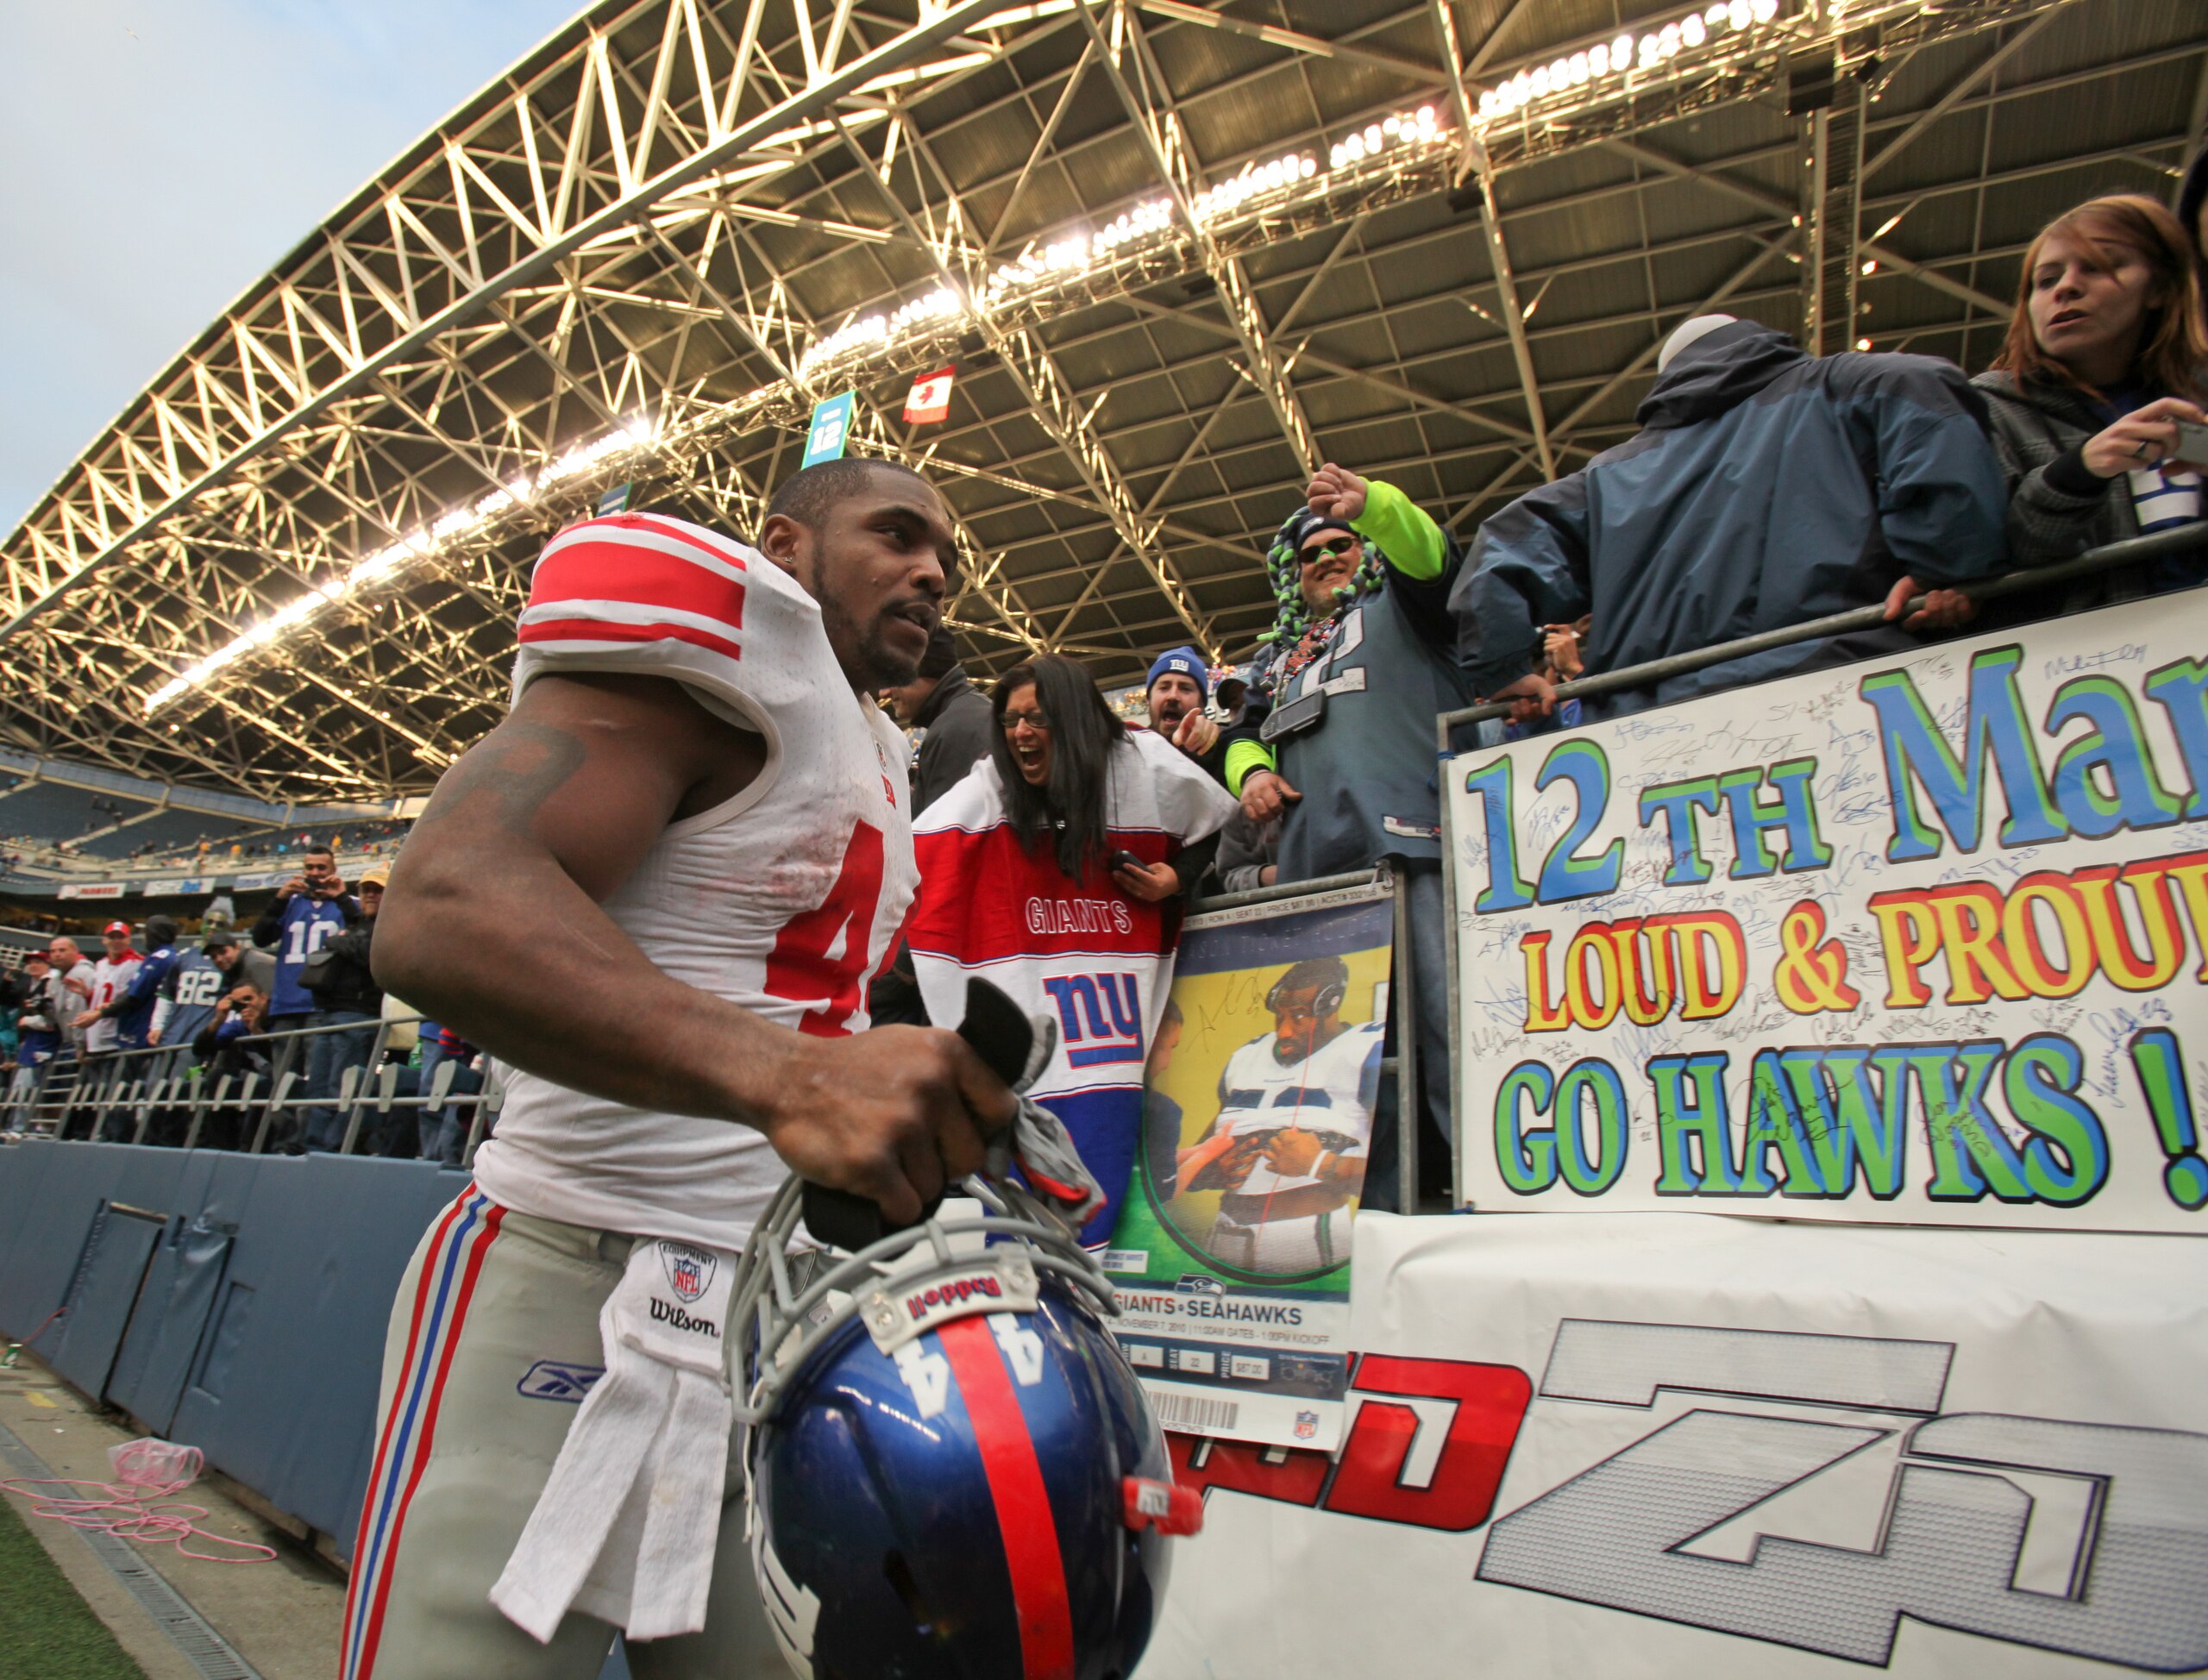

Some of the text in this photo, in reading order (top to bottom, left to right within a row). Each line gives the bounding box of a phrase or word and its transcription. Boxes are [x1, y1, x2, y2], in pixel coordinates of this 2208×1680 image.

[810, 420, 843, 455] 12
[1025, 896, 1132, 934] GIANTS
[1266, 902, 1289, 913] PRICE
[285, 920, 340, 964] 10
[1520, 909, 1748, 1032] LOUD
[1773, 899, 1860, 1016] &
[1867, 851, 2208, 1010] PROU
[176, 970, 223, 1006] 82
[1494, 1057, 1629, 1197] GO
[662, 1244, 714, 1266] EQUIPMENT
[674, 1270, 699, 1294] NFL
[906, 1276, 1002, 1320] Riddell
[649, 1296, 720, 1337] Wilson
[1187, 1299, 1302, 1326] SEAHAWKS
[1117, 1317, 1158, 1330] NOVEMBER
[1226, 1327, 1255, 1339] GATES
[1292, 1332, 1330, 1345] KICKOFF
[1169, 1348, 1179, 1370] SEAT
[1220, 1351, 1231, 1378] PRICE
